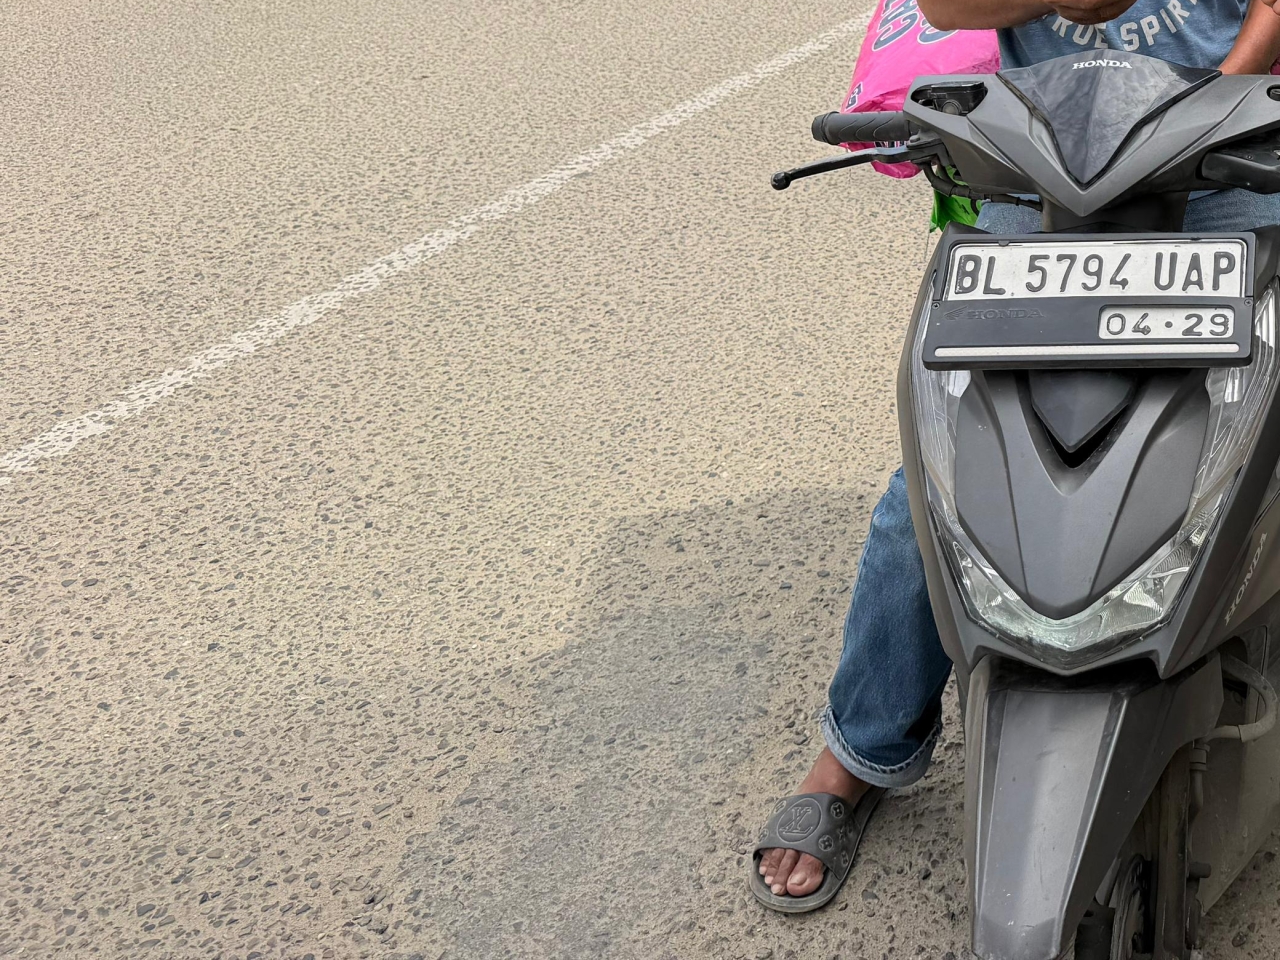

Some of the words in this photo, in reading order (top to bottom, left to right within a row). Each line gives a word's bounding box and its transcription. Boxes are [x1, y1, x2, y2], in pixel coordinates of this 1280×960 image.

[1046, 14, 1108, 49] RUE
[1072, 59, 1133, 70] HONDA
[955, 254, 1006, 296] BL
[1025, 253, 1132, 293] 5794
[1153, 251, 1237, 292] UAP
[967, 308, 1045, 320] HONDA
[1224, 532, 1268, 626] HONDA
